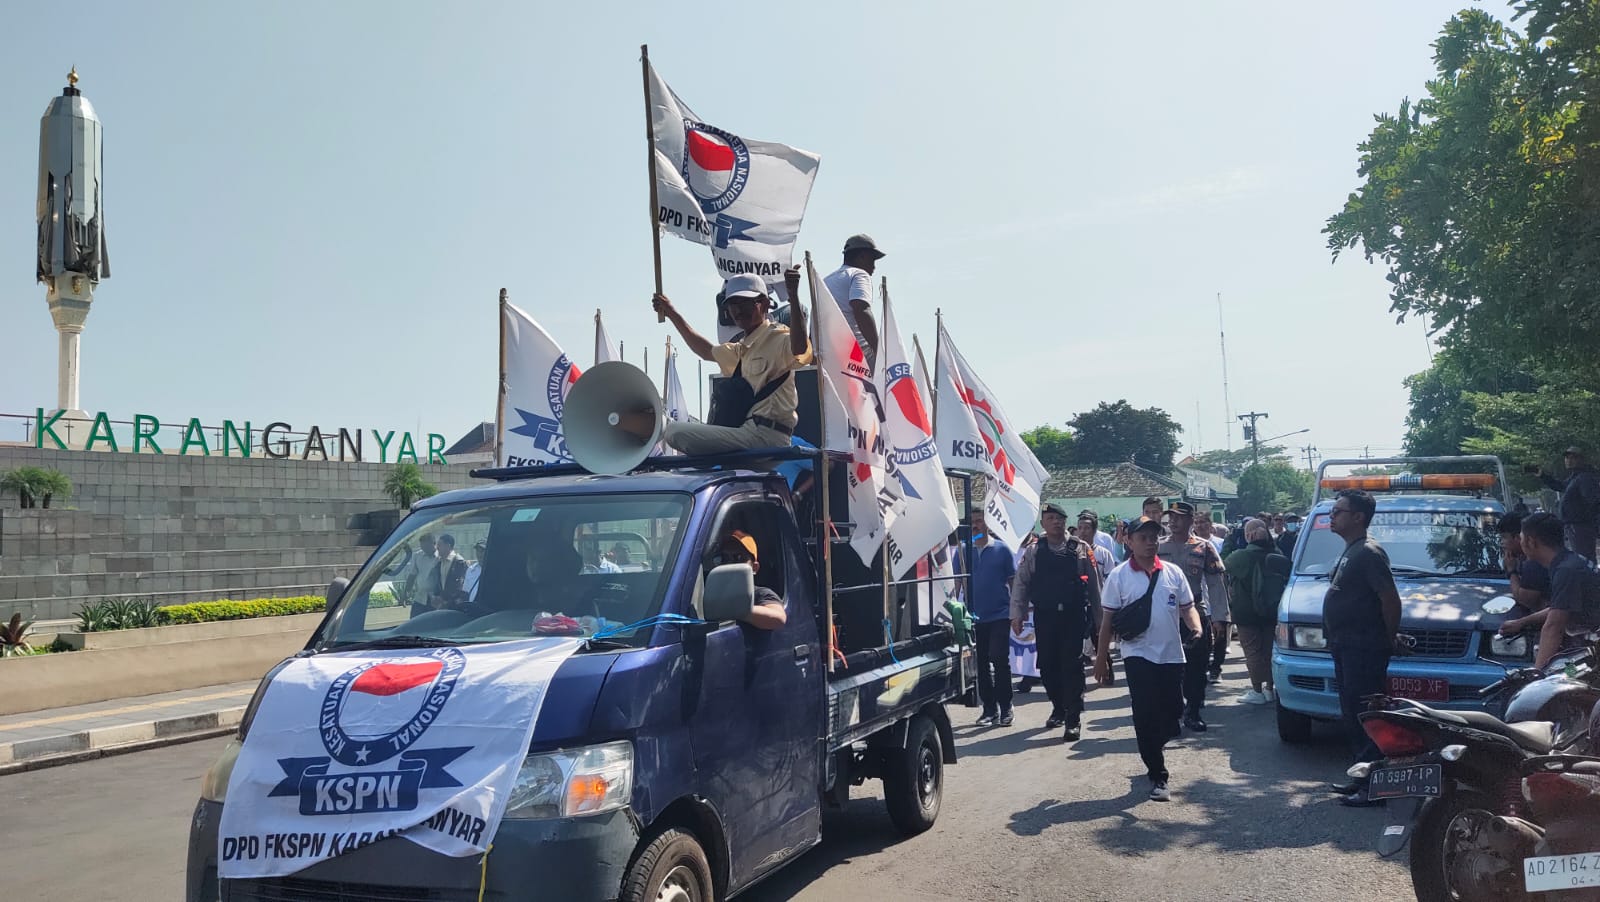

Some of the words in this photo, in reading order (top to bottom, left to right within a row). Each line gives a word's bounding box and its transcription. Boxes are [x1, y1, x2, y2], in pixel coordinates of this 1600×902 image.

[711, 167, 748, 211] NASIONAL
[659, 206, 683, 227] DPD
[687, 215, 711, 236] FKS
[718, 257, 781, 276] NGANYAR
[549, 366, 565, 419] ESATUAN
[35, 407, 449, 465] KARANGANYAR
[322, 678, 348, 757] KESATUAN
[388, 673, 458, 751] NASIONAL
[314, 774, 402, 812] KSPN
[222, 837, 259, 861] DPD
[264, 832, 326, 859] FKSPN
[1528, 860, 1545, 876] AD
[1549, 856, 1586, 874] 2164
